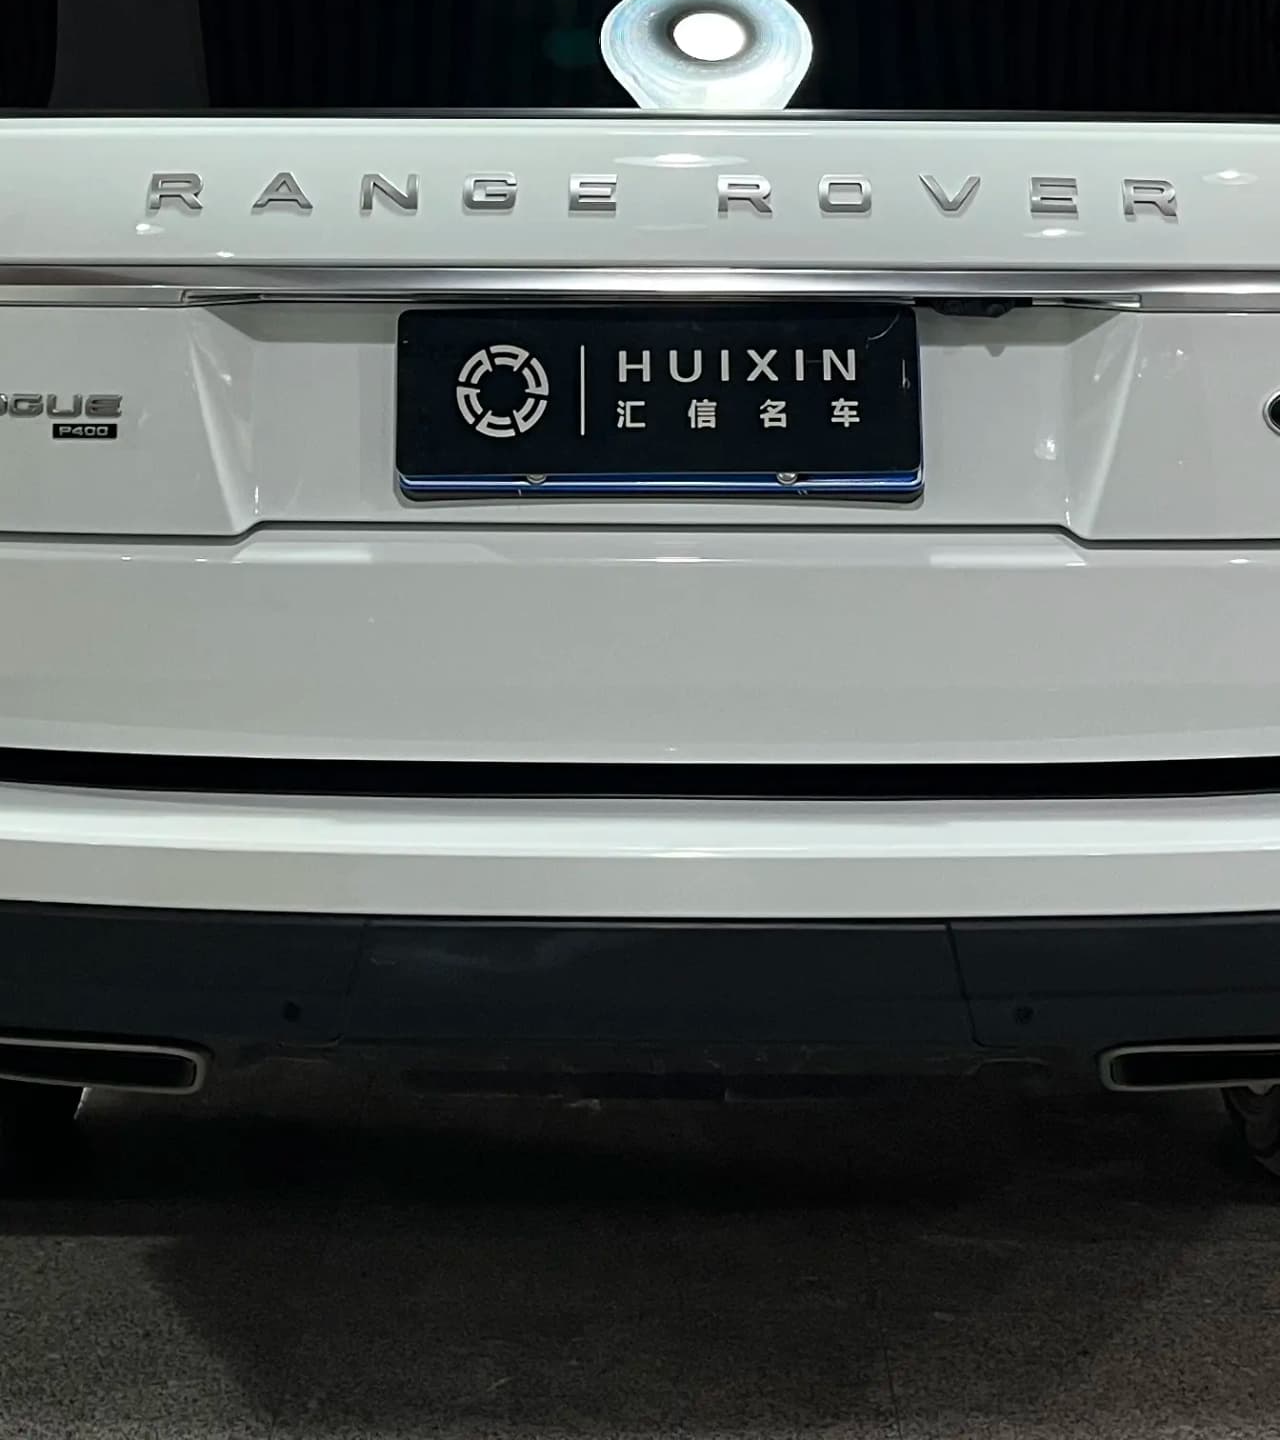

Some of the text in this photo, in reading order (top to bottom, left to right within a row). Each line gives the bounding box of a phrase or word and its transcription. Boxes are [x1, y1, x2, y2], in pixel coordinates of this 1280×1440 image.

[147, 171, 1180, 218] RANGE ROVER
[618, 349, 857, 383] HUIXIN
[616, 398, 861, 429] 汇信名车
[58, 425, 110, 438] P400
